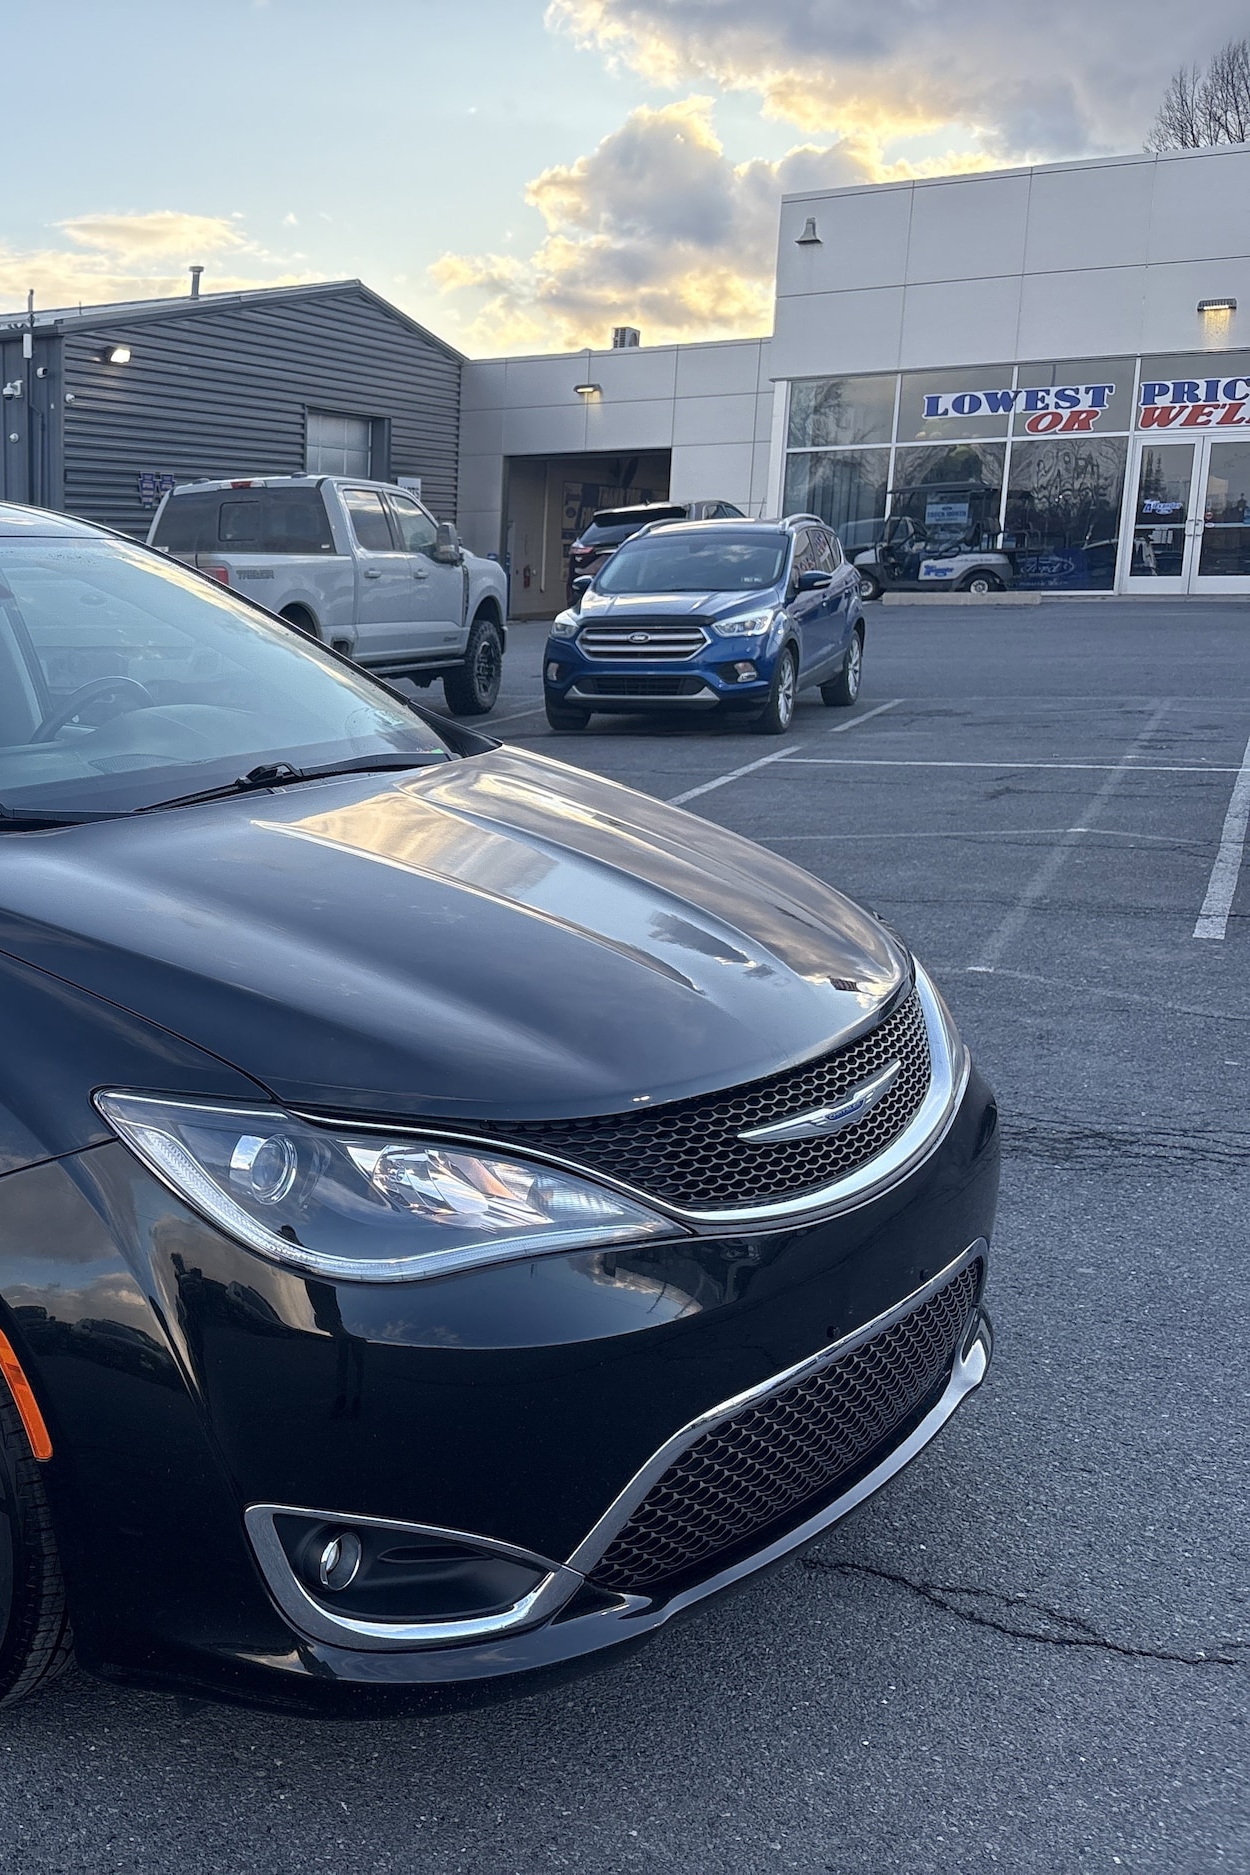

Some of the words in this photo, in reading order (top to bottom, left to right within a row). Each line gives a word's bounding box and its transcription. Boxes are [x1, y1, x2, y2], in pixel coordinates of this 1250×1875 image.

[924, 385, 1114, 417] LOWEST
[1141, 379, 1250, 405] PRIC
[1027, 409, 1100, 433] OR
[1140, 402, 1250, 428] WE'L
